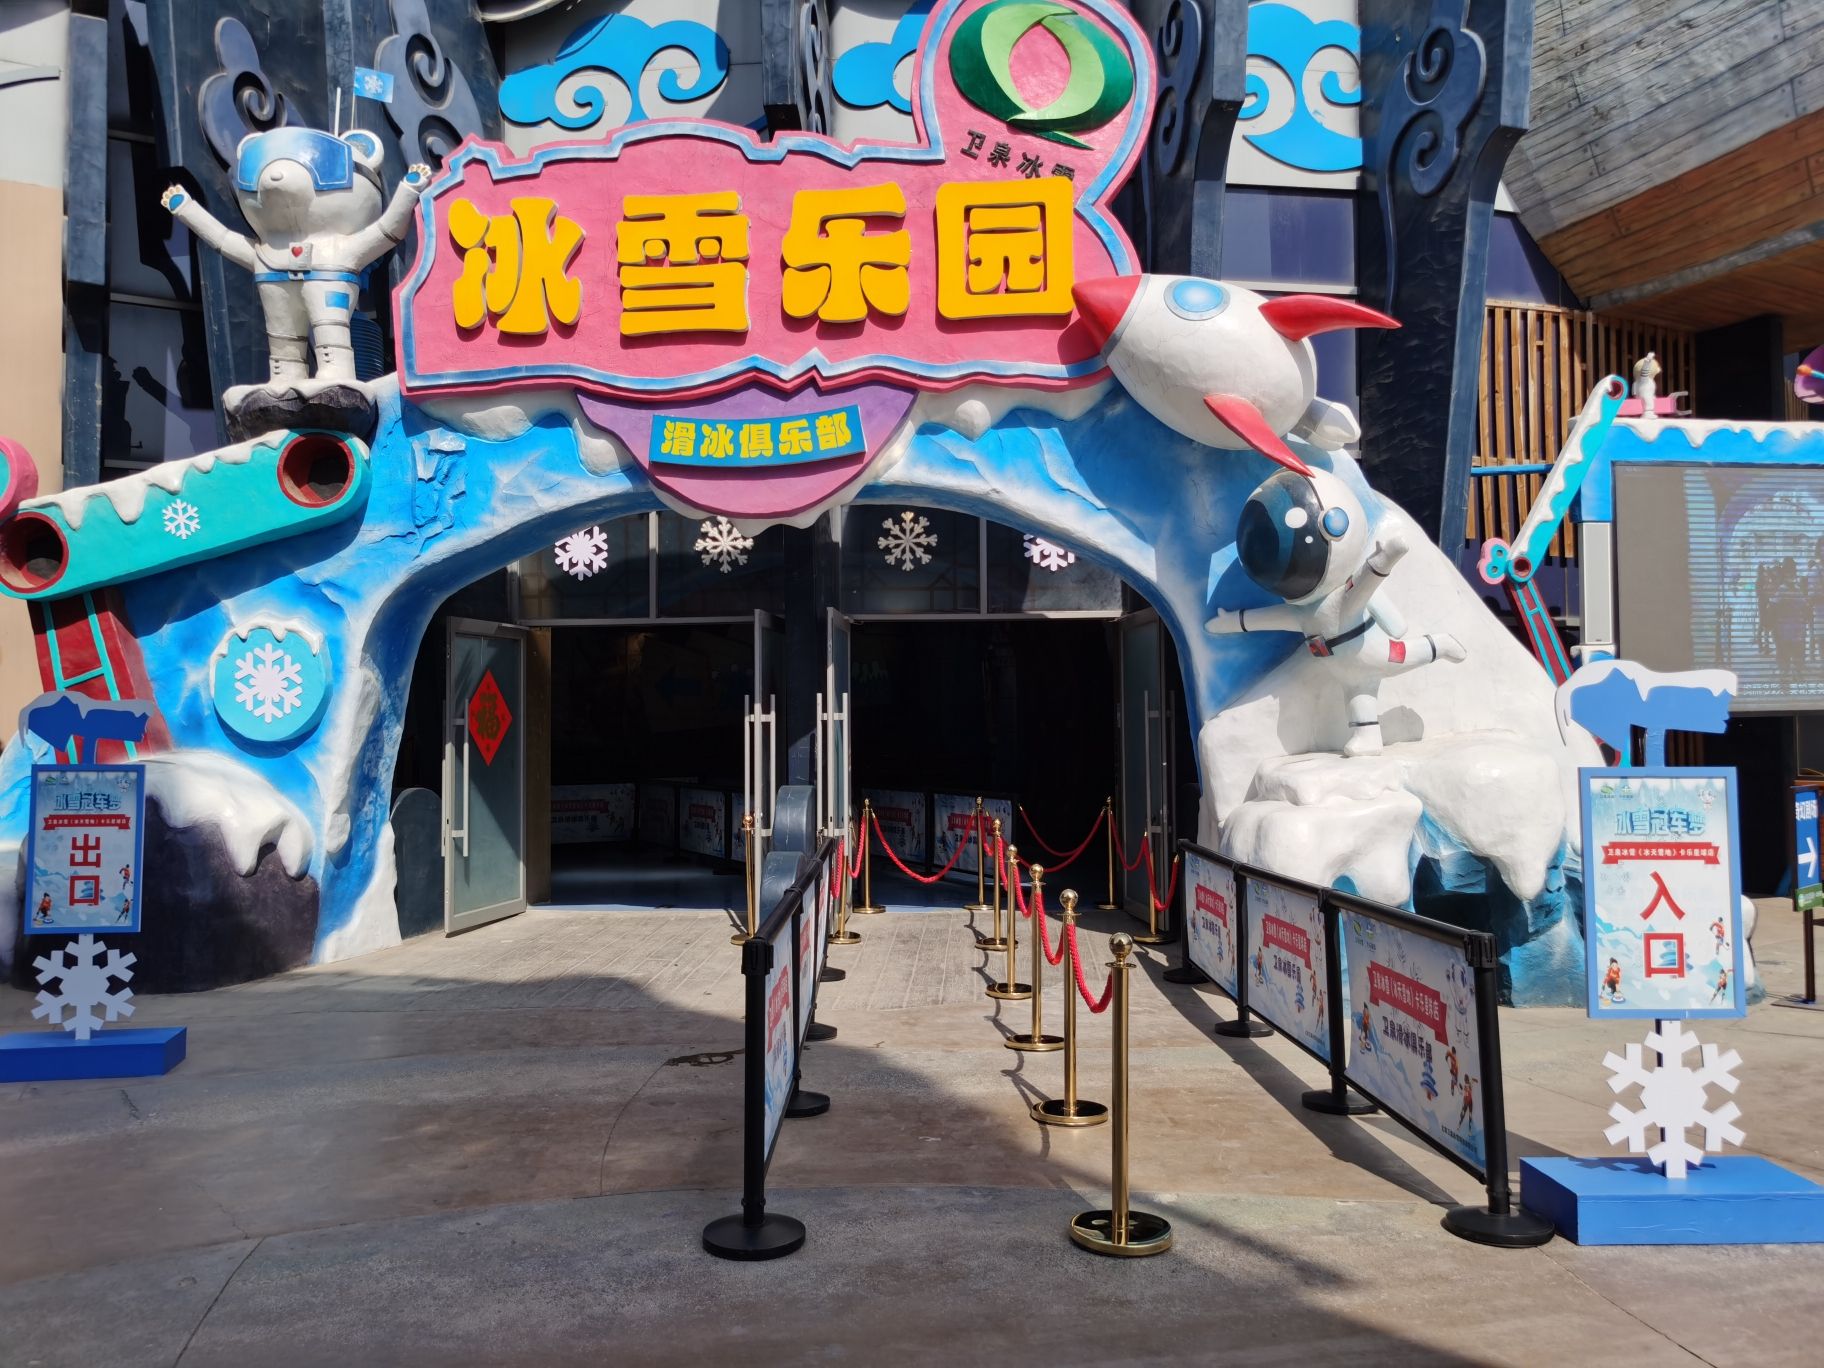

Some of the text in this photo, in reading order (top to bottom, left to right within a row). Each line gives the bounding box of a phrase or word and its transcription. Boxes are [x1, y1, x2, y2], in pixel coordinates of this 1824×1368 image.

[448, 181, 1073, 335] 冰雪乐园
[660, 411, 852, 458] 滑冰俱乐部
[69, 834, 101, 906] 出口
[1640, 871, 1686, 978] 入口
